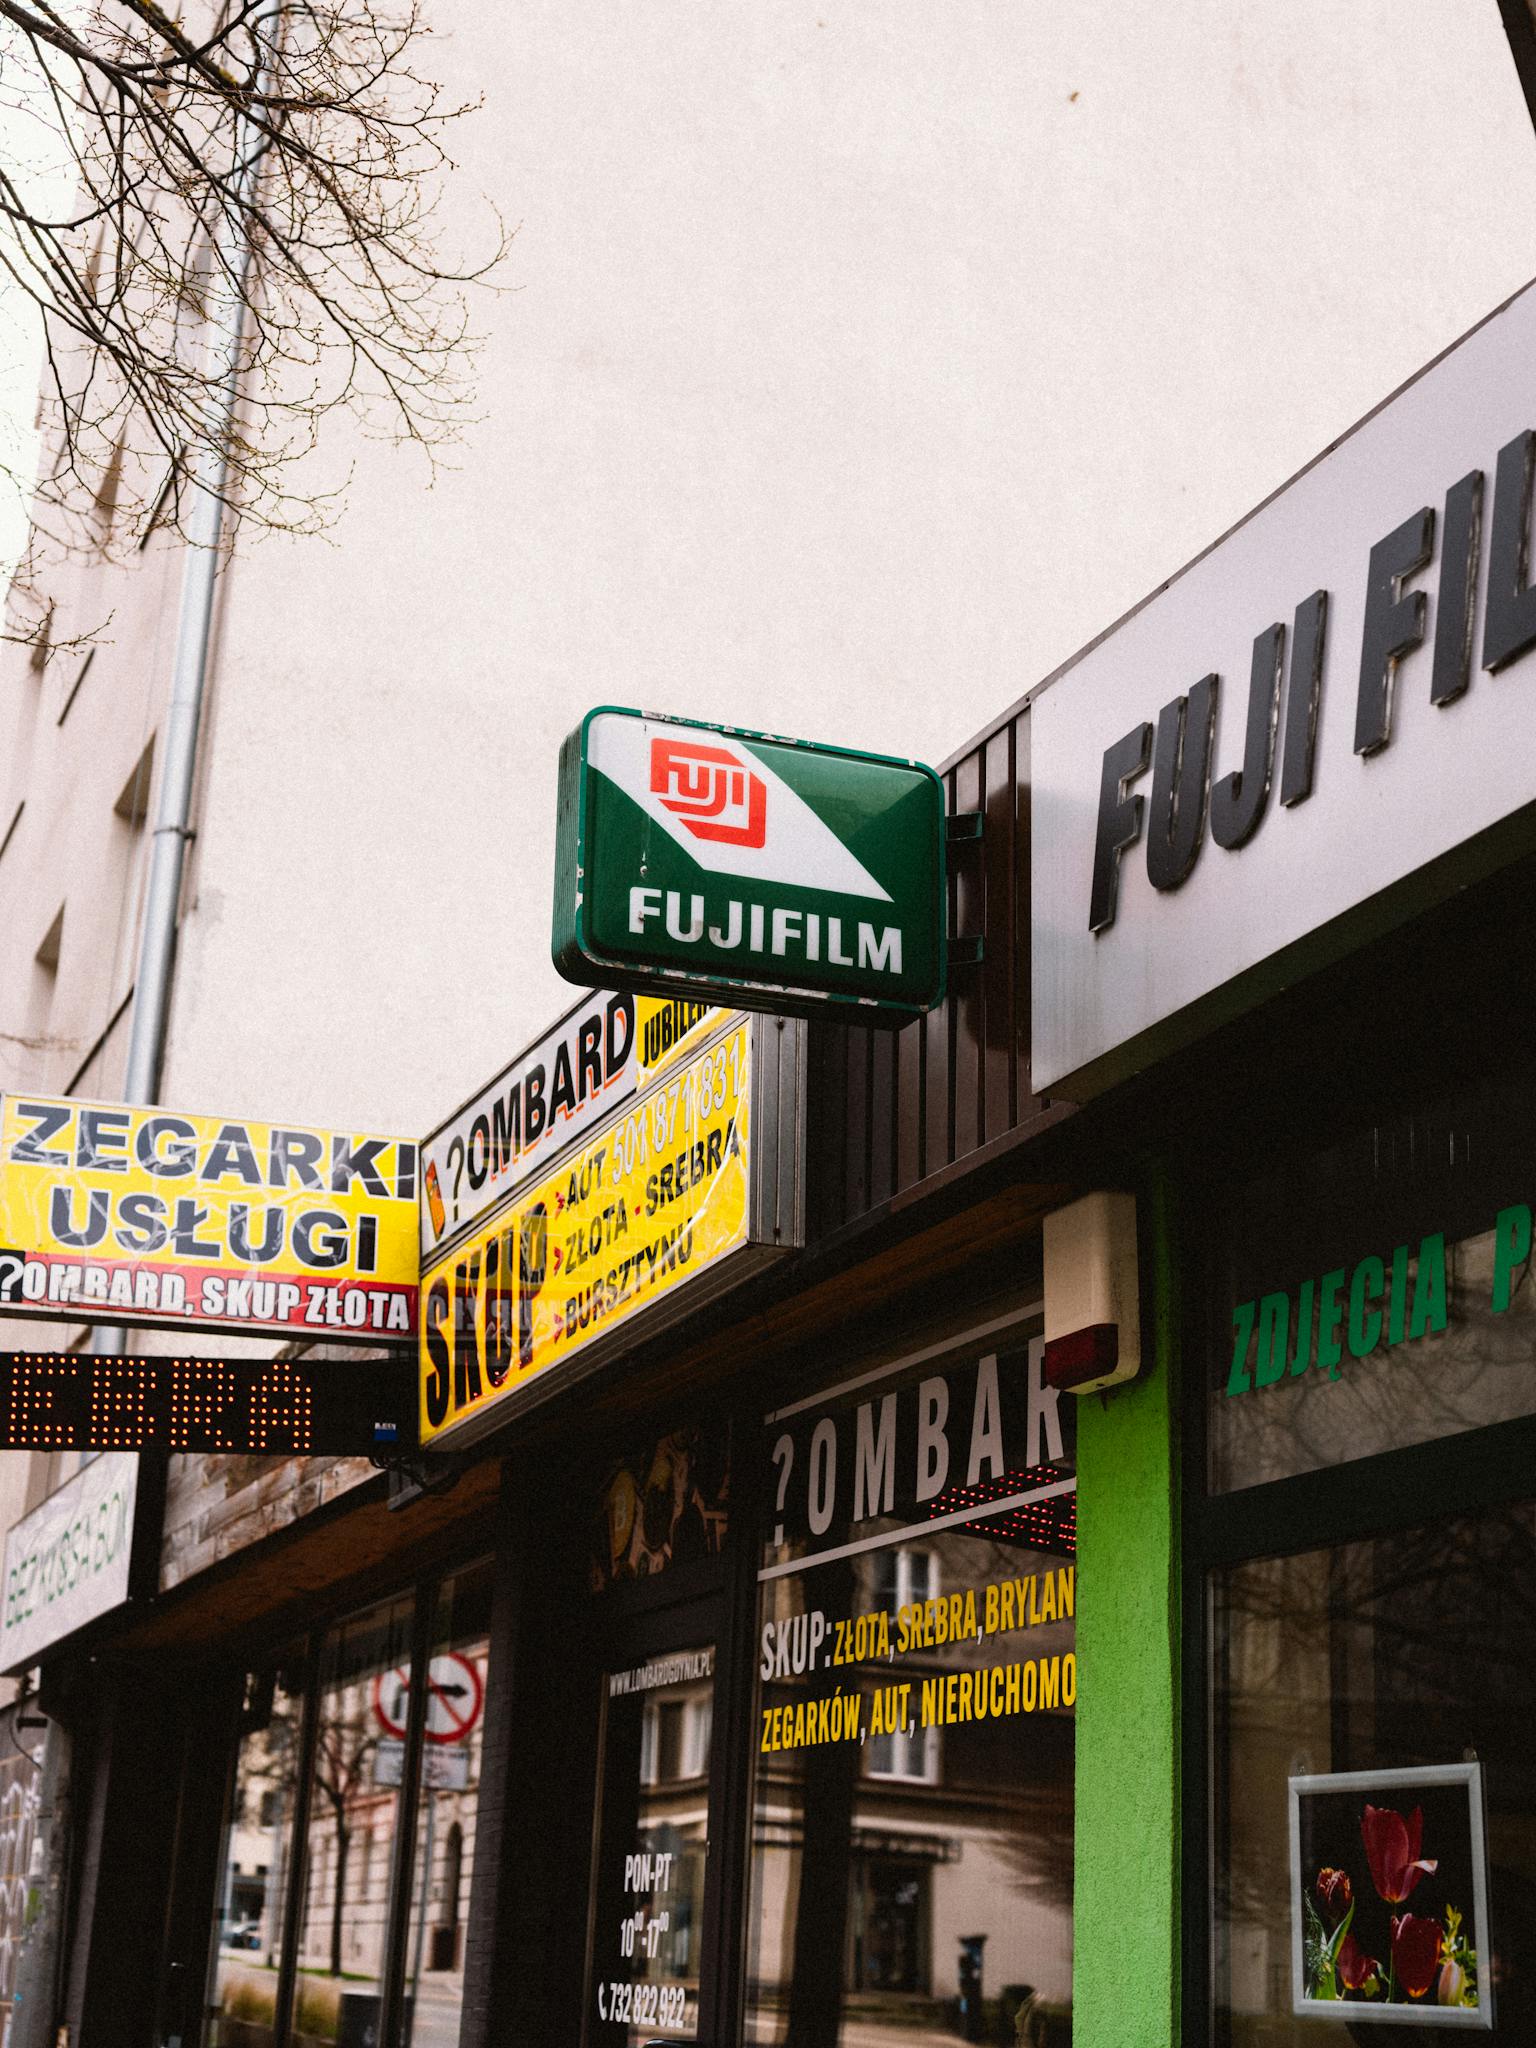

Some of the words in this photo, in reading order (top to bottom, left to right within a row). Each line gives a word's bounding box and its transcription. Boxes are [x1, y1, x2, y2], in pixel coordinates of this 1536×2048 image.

[654, 743, 760, 842] FUJI
[1089, 588, 1328, 934] FUJI
[629, 887, 902, 974] FUJIFILM
[10, 1104, 417, 1200] ZEGARKI
[612, 1105, 647, 1184] 501
[654, 1071, 692, 1153] 871
[700, 1033, 740, 1120] 831
[565, 1204, 628, 1275] ZŁOTA
[645, 1117, 740, 1217] SREBRA
[567, 1149, 606, 1208] AUT
[50, 1186, 378, 1273] USŁUGI
[201, 1277, 300, 1321] SKUP
[305, 1286, 410, 1331] ZŁOTA
[426, 1202, 548, 1428] SKUP
[566, 1217, 693, 1339] BURSZTYNU
[1226, 1231, 1448, 1397] ZDJĘCIA
[9, 1356, 311, 1449] EBRA
[760, 1611, 832, 1682] SKUP:
[833, 1611, 895, 1664] ZŁOTA,
[896, 1589, 983, 1652] SREBRA,
[986, 1566, 1074, 1634] BRYLAN
[761, 1687, 865, 1753] ZEGARKÓW,
[870, 1684, 915, 1738] AUT,
[625, 1853, 672, 1892] PON-PT
[609, 1983, 630, 2023] 732
[633, 1985, 656, 2026] 822
[659, 1987, 685, 2029] 922
